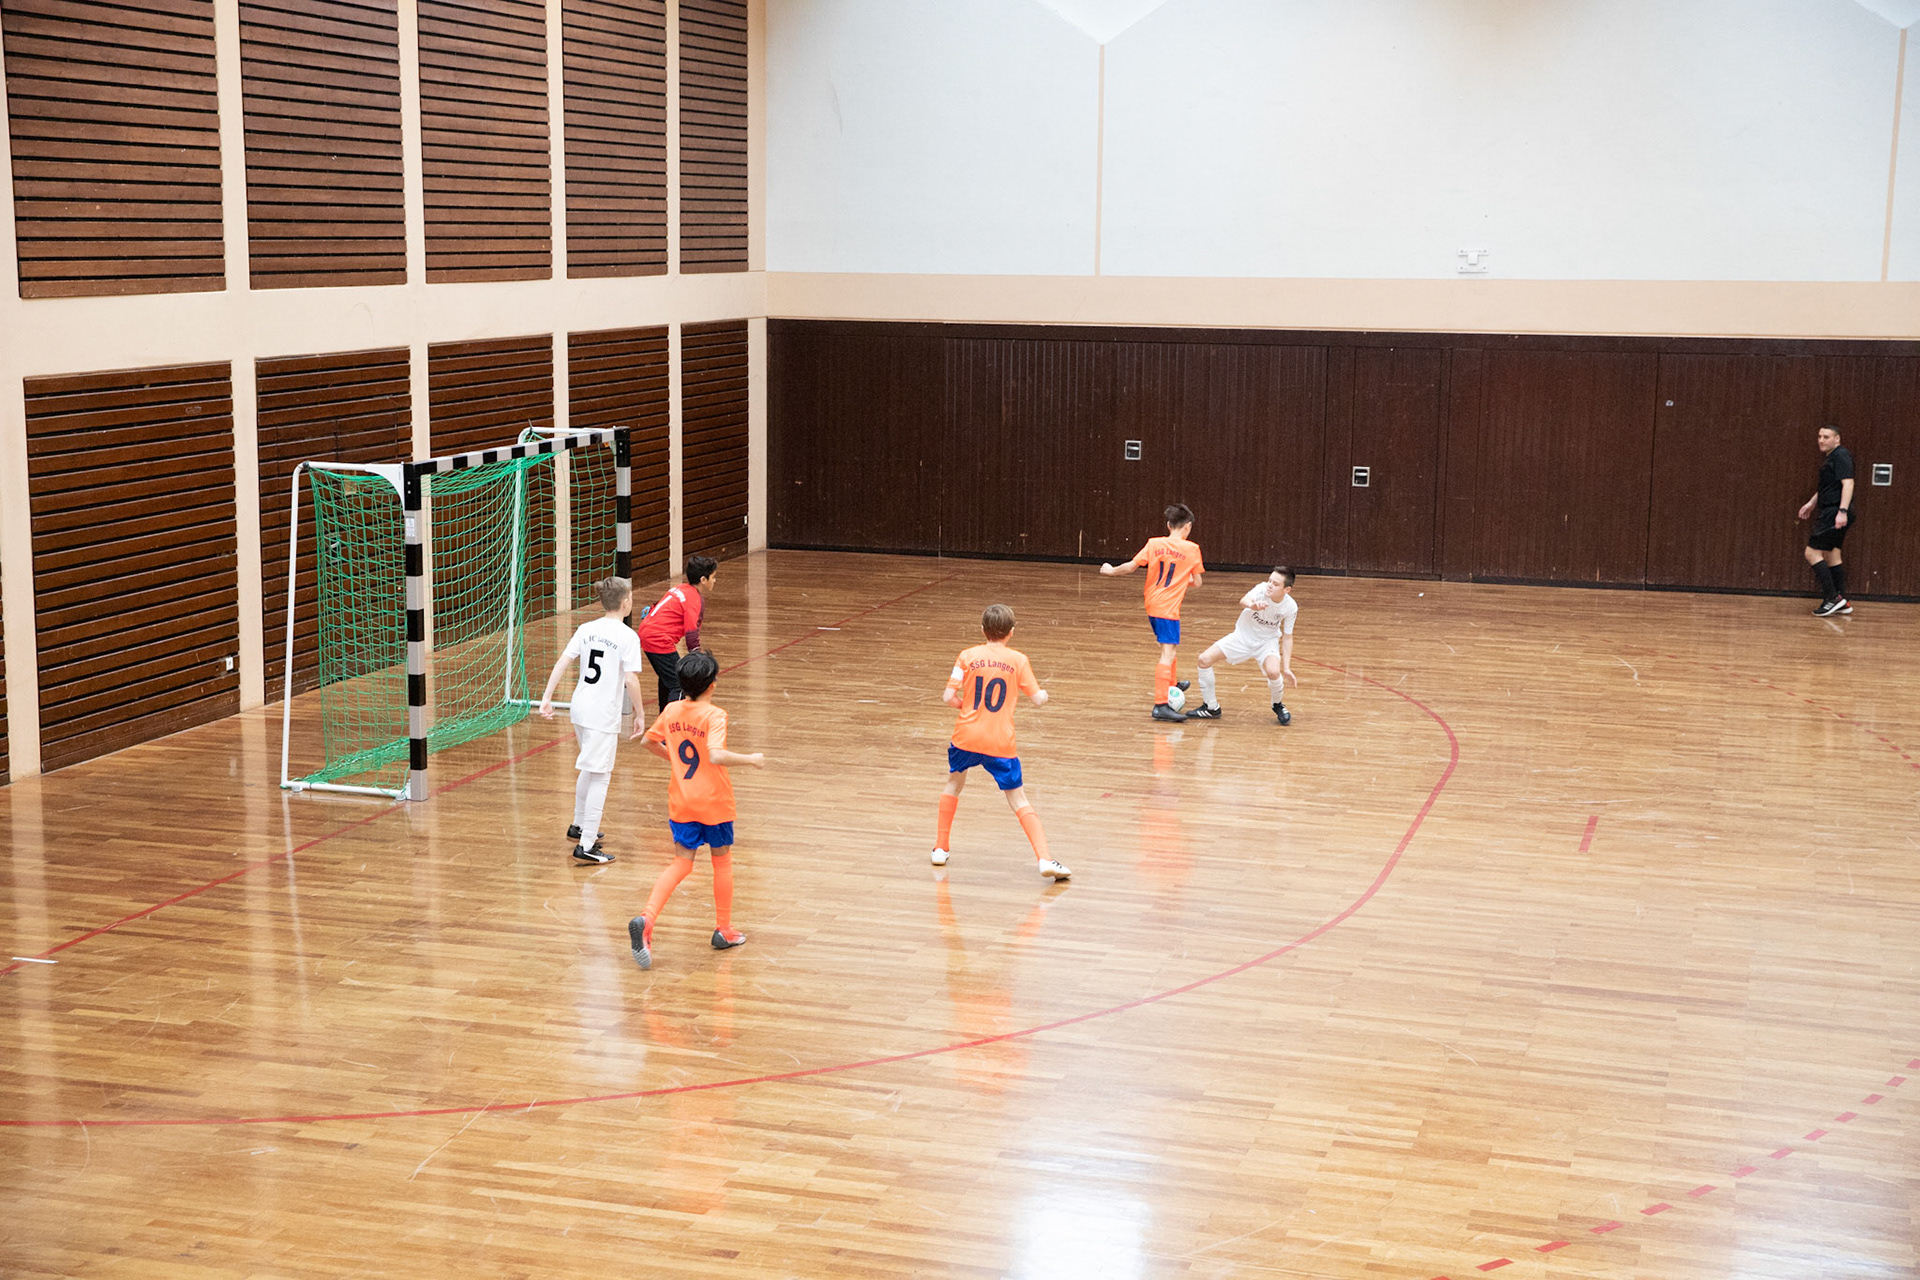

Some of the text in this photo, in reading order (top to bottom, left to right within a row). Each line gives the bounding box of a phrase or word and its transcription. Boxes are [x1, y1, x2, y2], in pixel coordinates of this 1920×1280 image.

[1156, 561, 1176, 587] 11
[584, 649, 604, 684] 5
[970, 660, 1015, 674] SSG Langen
[973, 675, 1007, 712] 10
[668, 722, 705, 738] SSG Langen
[678, 739, 700, 779] 9
